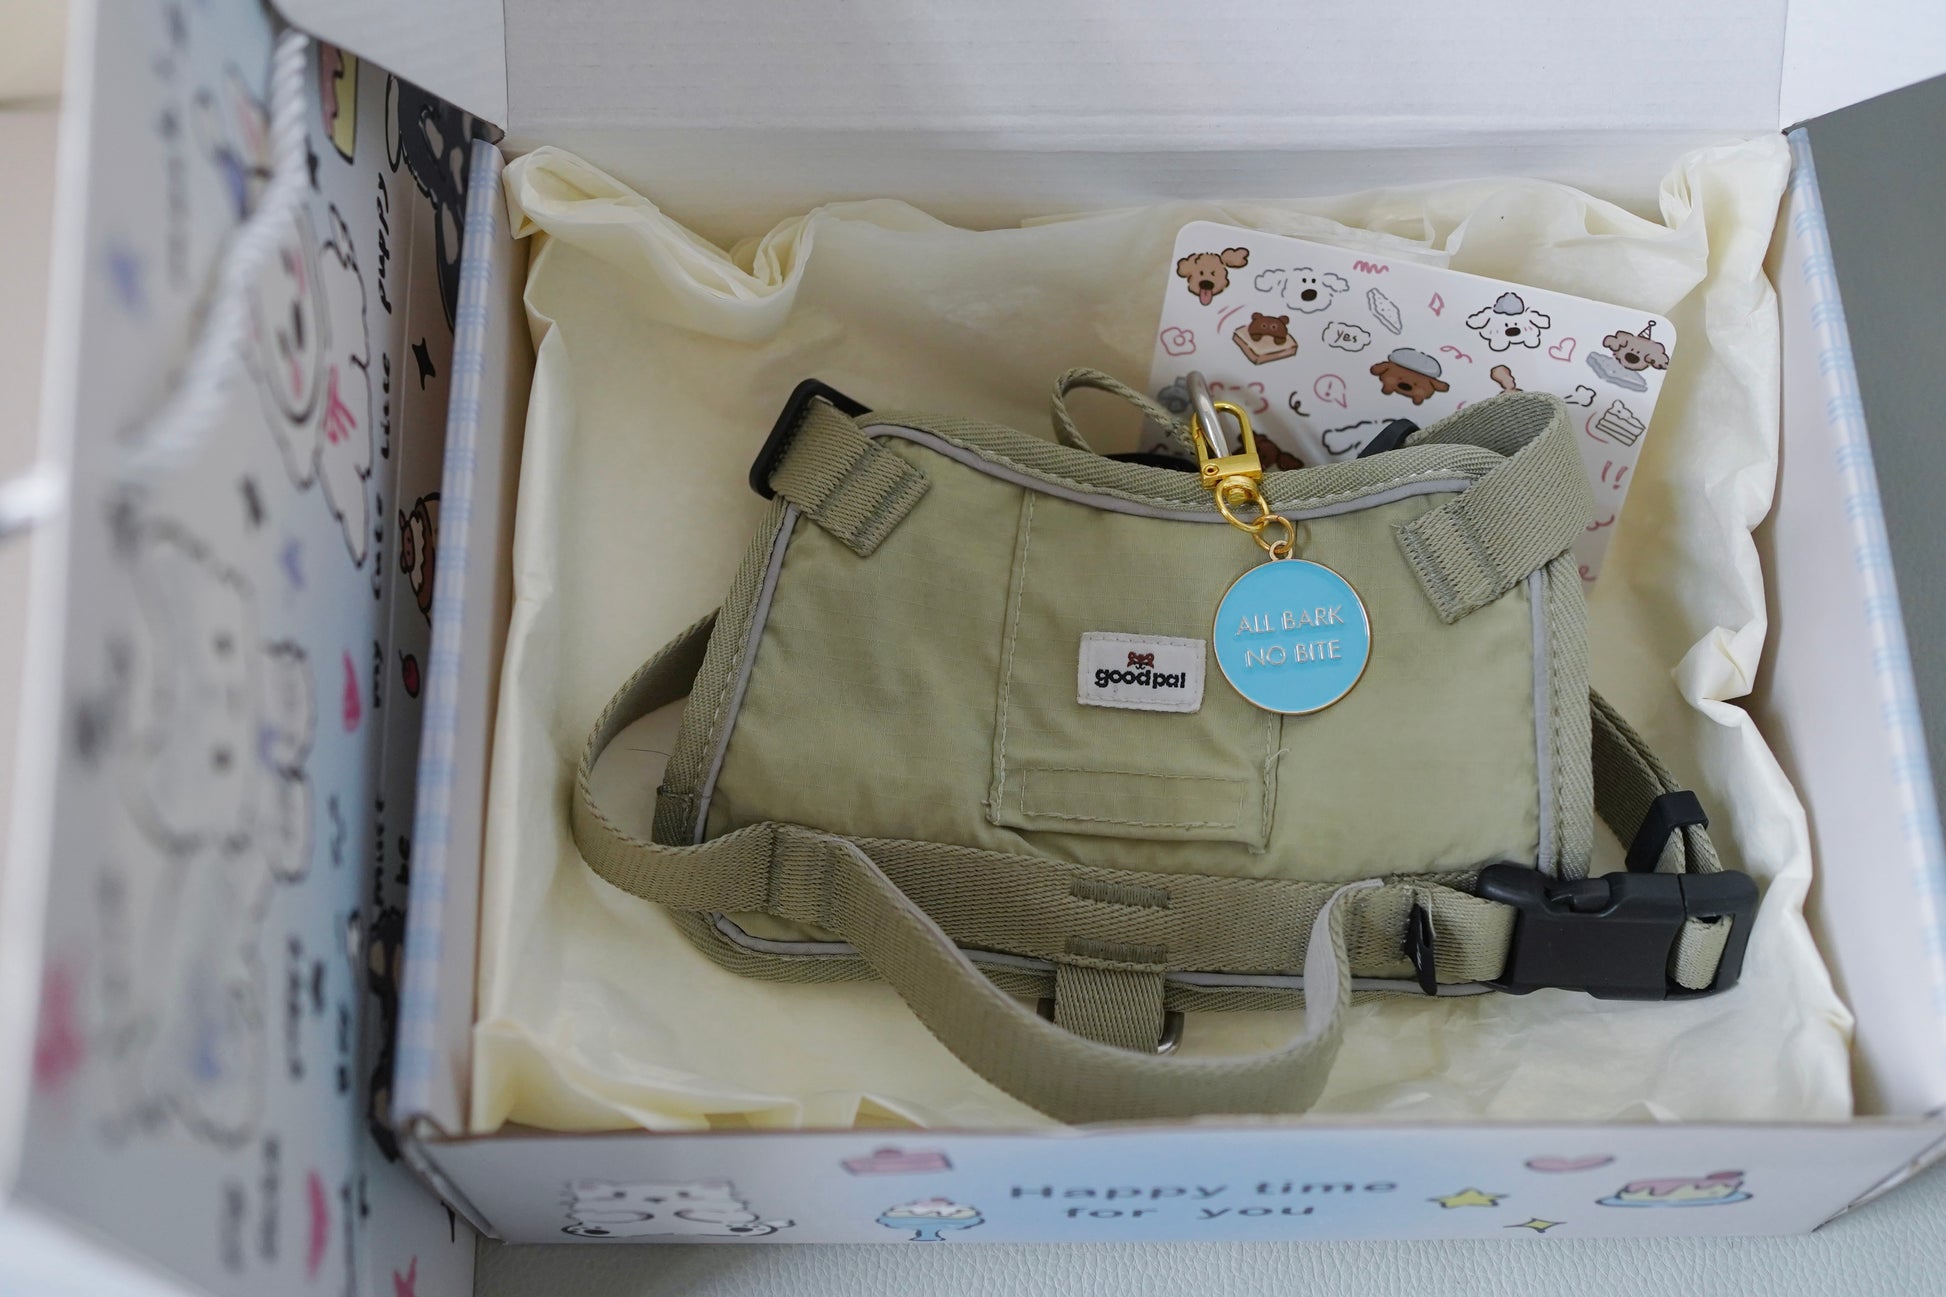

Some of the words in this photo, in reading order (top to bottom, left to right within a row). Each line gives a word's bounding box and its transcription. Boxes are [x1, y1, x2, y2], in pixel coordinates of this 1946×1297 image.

[1334, 329, 1358, 343] yes
[1234, 613, 1276, 637] ALL
[1281, 604, 1345, 632] BARK
[1244, 645, 1287, 668] NO
[1294, 639, 1343, 663] BITE
[1010, 1184, 1228, 1199] Happy
[1255, 1182, 1398, 1196] time
[1066, 1207, 1160, 1218] for
[1199, 1206, 1315, 1219] you
